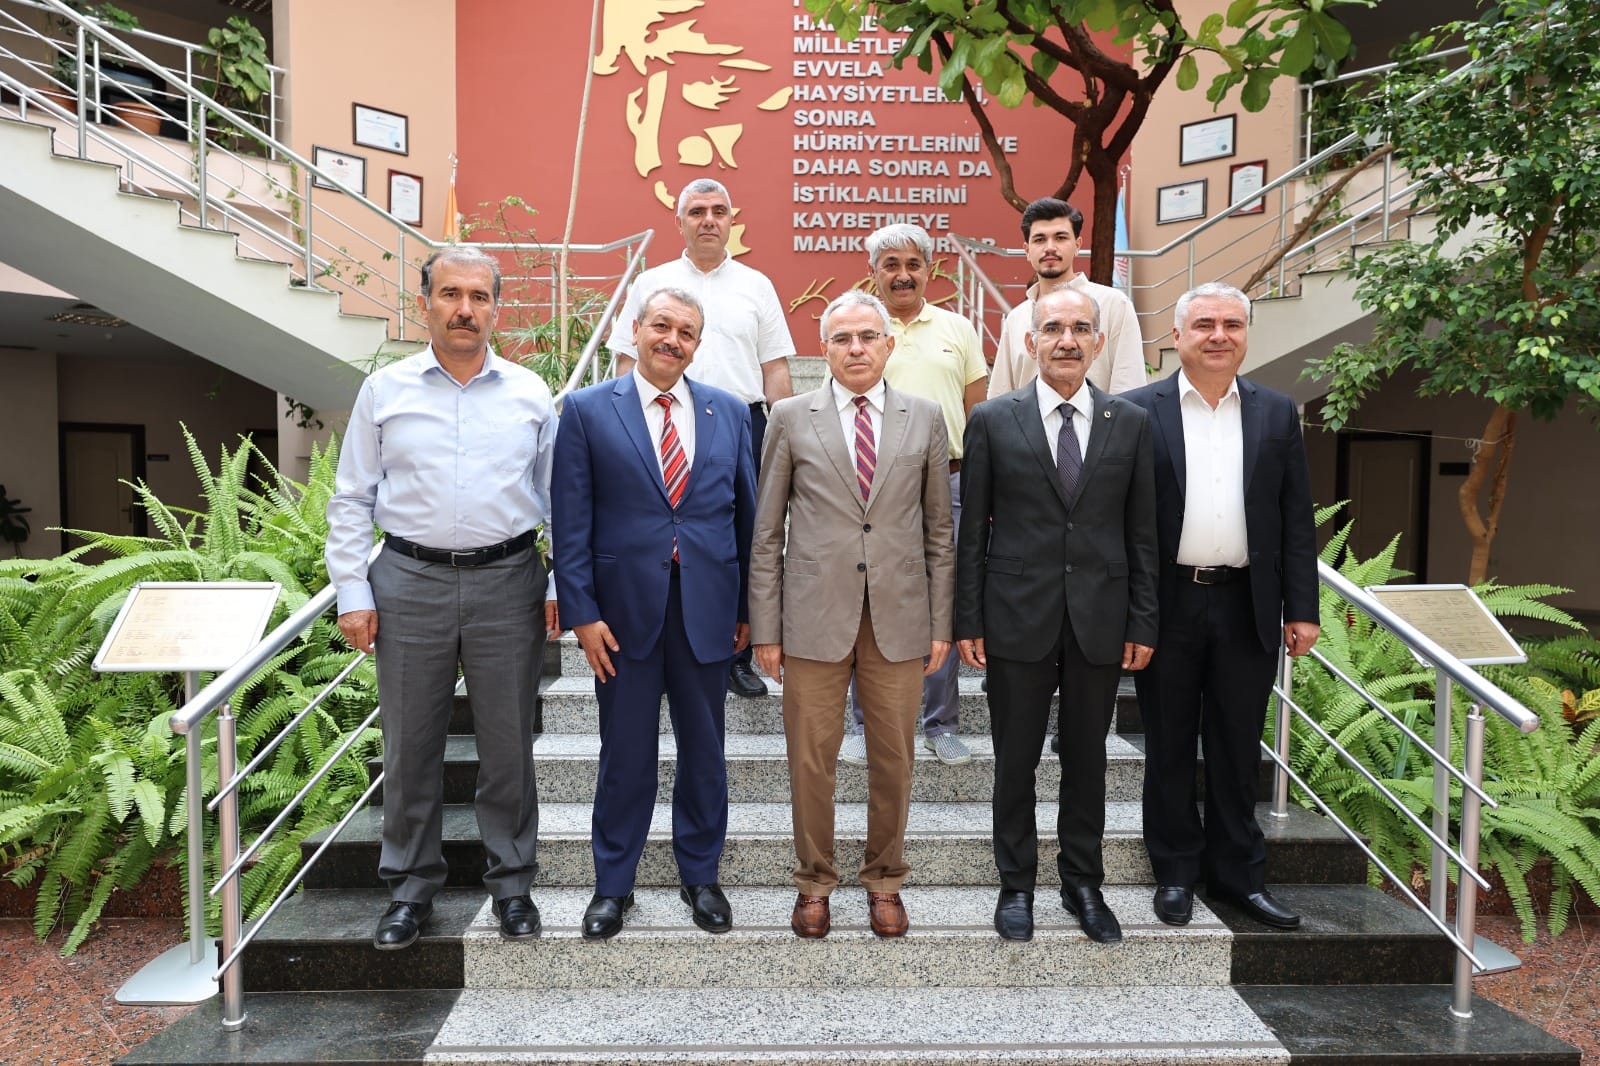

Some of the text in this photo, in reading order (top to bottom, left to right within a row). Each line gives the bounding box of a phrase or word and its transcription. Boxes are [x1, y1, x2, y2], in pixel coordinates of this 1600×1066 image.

[793, 60, 884, 77] EVVELA
[794, 109, 876, 127] SONRA
[793, 130, 980, 153] HÜRRİYETLERİNİ
[793, 158, 992, 177] DAHA SONRA DA
[793, 182, 967, 204] İSTİKLALLERİNİ
[793, 212, 949, 229] KAYBETMEYE
